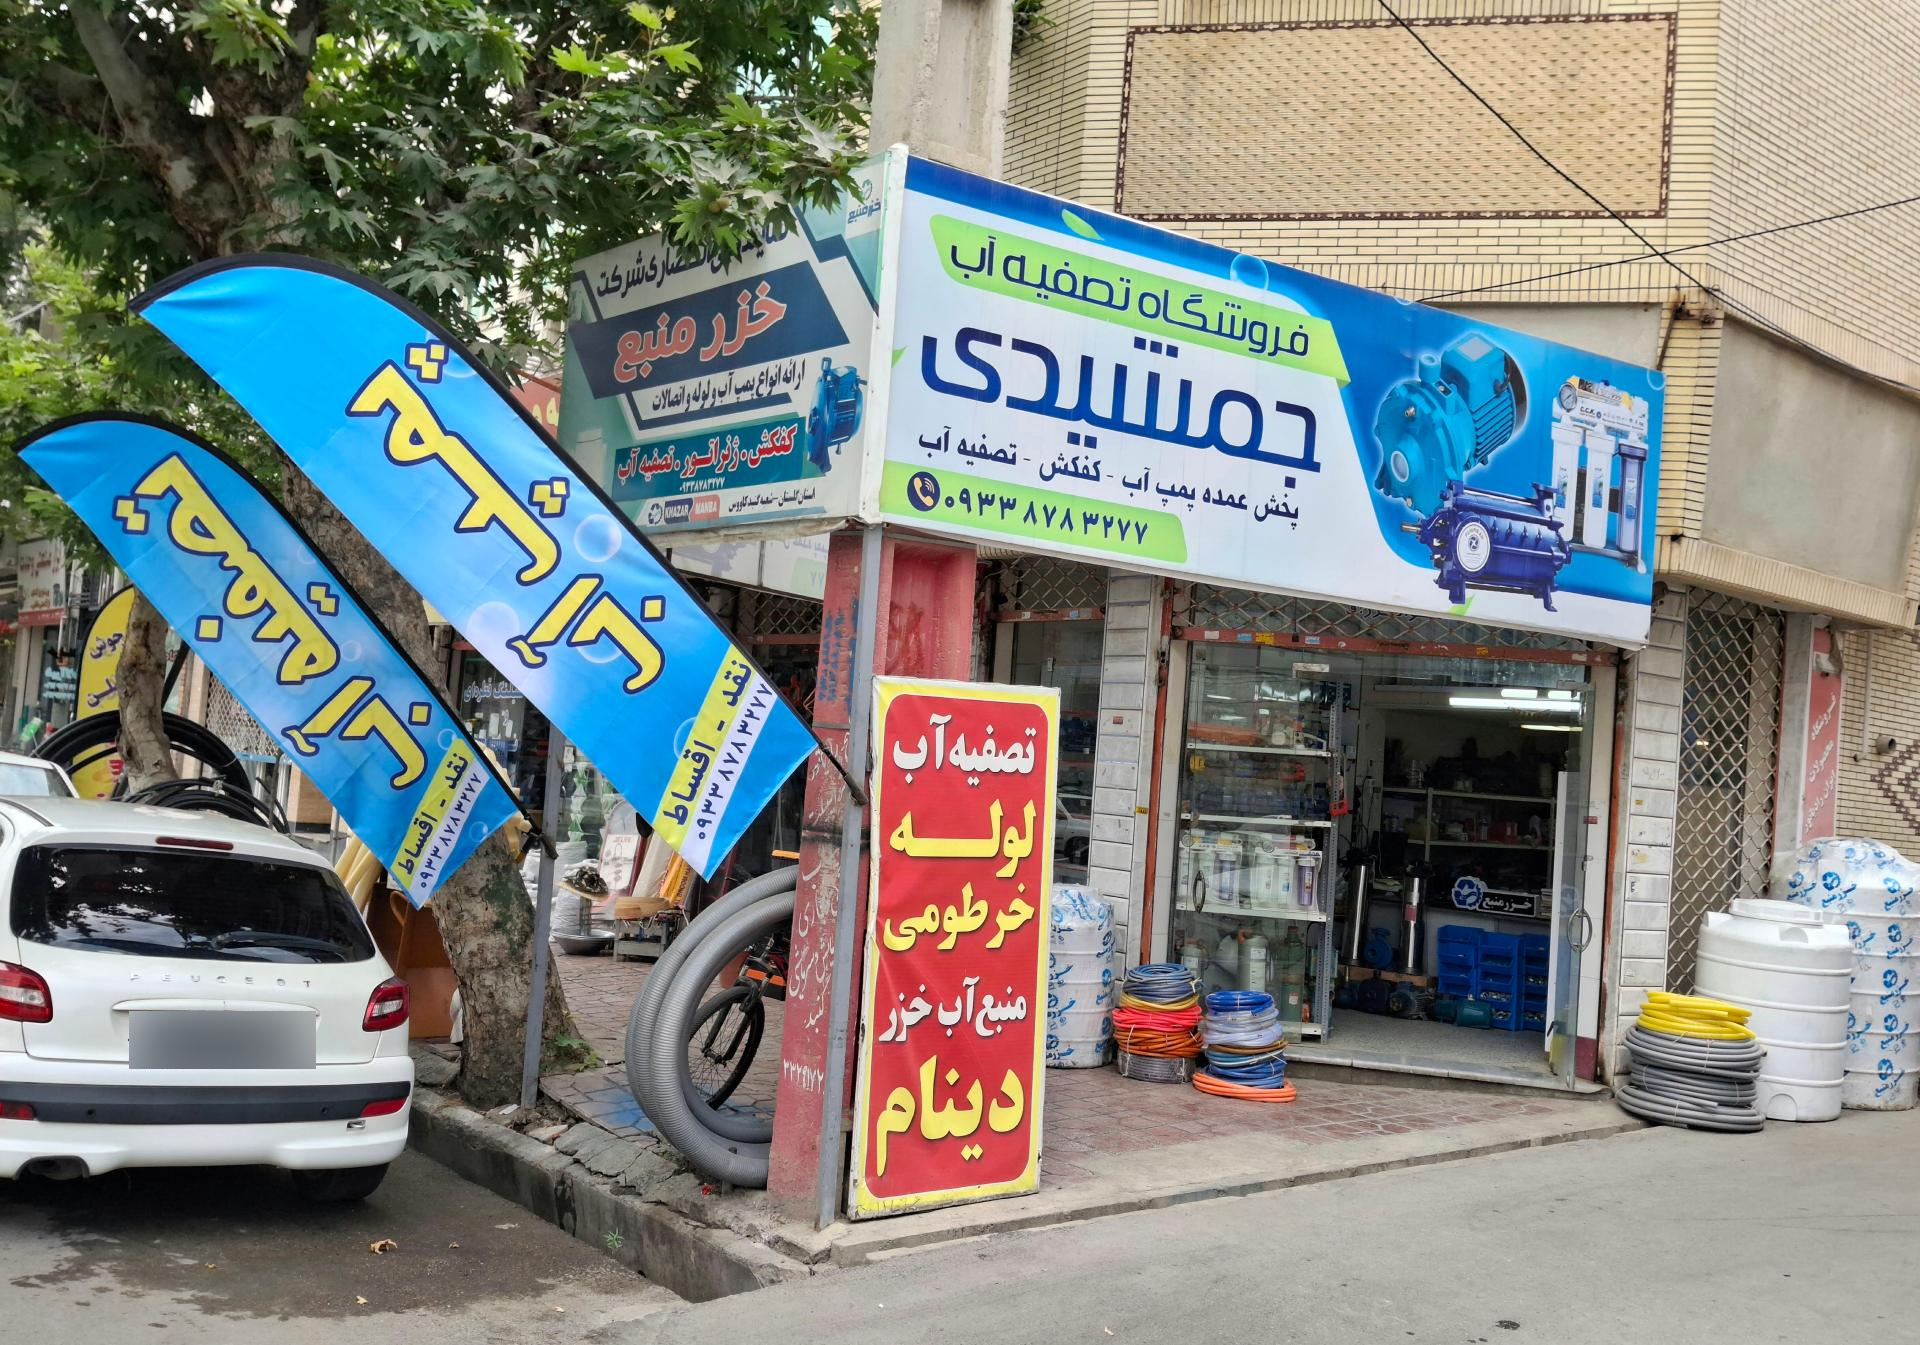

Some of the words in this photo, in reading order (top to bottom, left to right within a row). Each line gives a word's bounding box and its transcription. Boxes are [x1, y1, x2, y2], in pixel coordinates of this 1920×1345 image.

[597, 249, 645, 298] شرکت
[950, 235, 997, 279] آب
[1003, 254, 1131, 312] تصفیه
[700, 281, 787, 362] خزر
[1138, 289, 1310, 358] فروشگاه
[613, 310, 696, 384] منبع
[692, 379, 710, 408] لوله
[718, 371, 734, 403] آب
[734, 376, 755, 403] پمپ
[756, 363, 781, 397] انواع
[782, 358, 806, 390] ارائه
[652, 385, 685, 412] اتصالات
[921, 326, 1322, 489] جمشیدی
[639, 445, 675, 481] تصفیه
[680, 434, 740, 479] ژنراتور
[748, 424, 798, 469] کفکش
[918, 426, 951, 459] آب
[957, 433, 1017, 466] تصفیه
[618, 448, 641, 486] آب
[1039, 453, 1101, 482] کفکش
[1122, 467, 1151, 498] آب
[345, 340, 571, 586] پمپ
[506, 574, 666, 694] آب
[665, 504, 689, 518] KHAZAR
[694, 501, 718, 515] MANBA
[945, 488, 1017, 520] ۰۹۳۳
[1023, 501, 1074, 532] ۸۷۸
[1083, 511, 1149, 545] ۳۲۷۷
[1155, 480, 1196, 512] پمپ
[1202, 487, 1247, 511] عمده
[1254, 493, 1299, 530] پخش
[112, 451, 341, 684] تصفیه
[282, 676, 432, 790] آب
[722, 659, 752, 707] نقد
[445, 753, 469, 789] نقد
[696, 782, 724, 840] ۰۹۳۳
[718, 741, 747, 782] ۸۷۸
[737, 683, 773, 736] ۳۲۷۷
[892, 713, 952, 784] آب
[949, 723, 1037, 786] تصفیه
[663, 739, 716, 826] اقساط
[398, 811, 438, 875] اقساط
[889, 798, 1037, 878] لوله
[883, 881, 1036, 952] خرطومی
[1482, 896, 1504, 910] منبع
[1503, 898, 1532, 912] خزر
[129, 974, 311, 988] PEUGEOT
[878, 983, 933, 1042] خزر
[938, 975, 980, 1037] آب
[975, 986, 1028, 1037] منبع
[876, 1054, 1025, 1178] دینام
